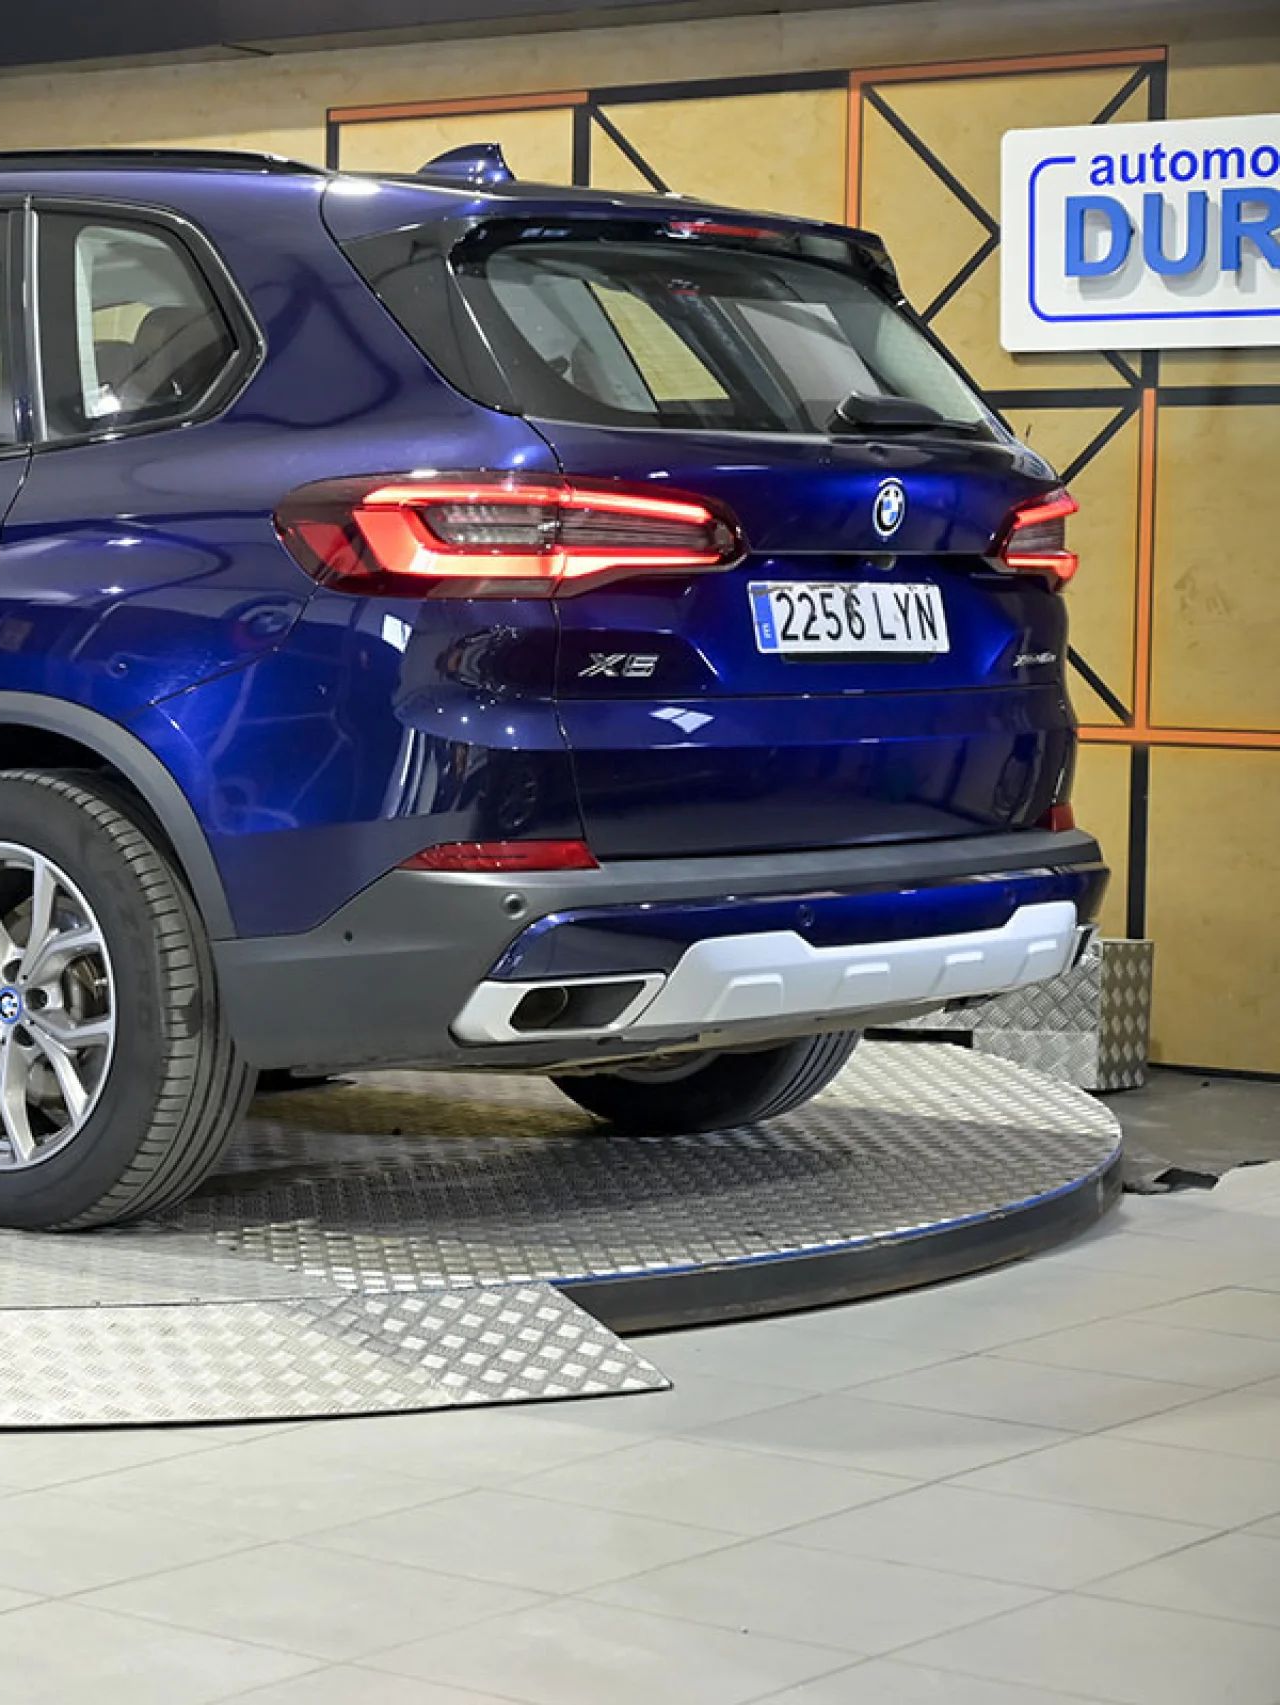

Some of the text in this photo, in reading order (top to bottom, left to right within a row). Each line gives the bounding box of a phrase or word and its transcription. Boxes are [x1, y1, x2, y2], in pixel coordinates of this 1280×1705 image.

[1089, 142, 1280, 186] automo
[1064, 187, 1280, 278] DUR
[775, 592, 938, 641] 2256 LYN
[577, 652, 660, 677] X5
